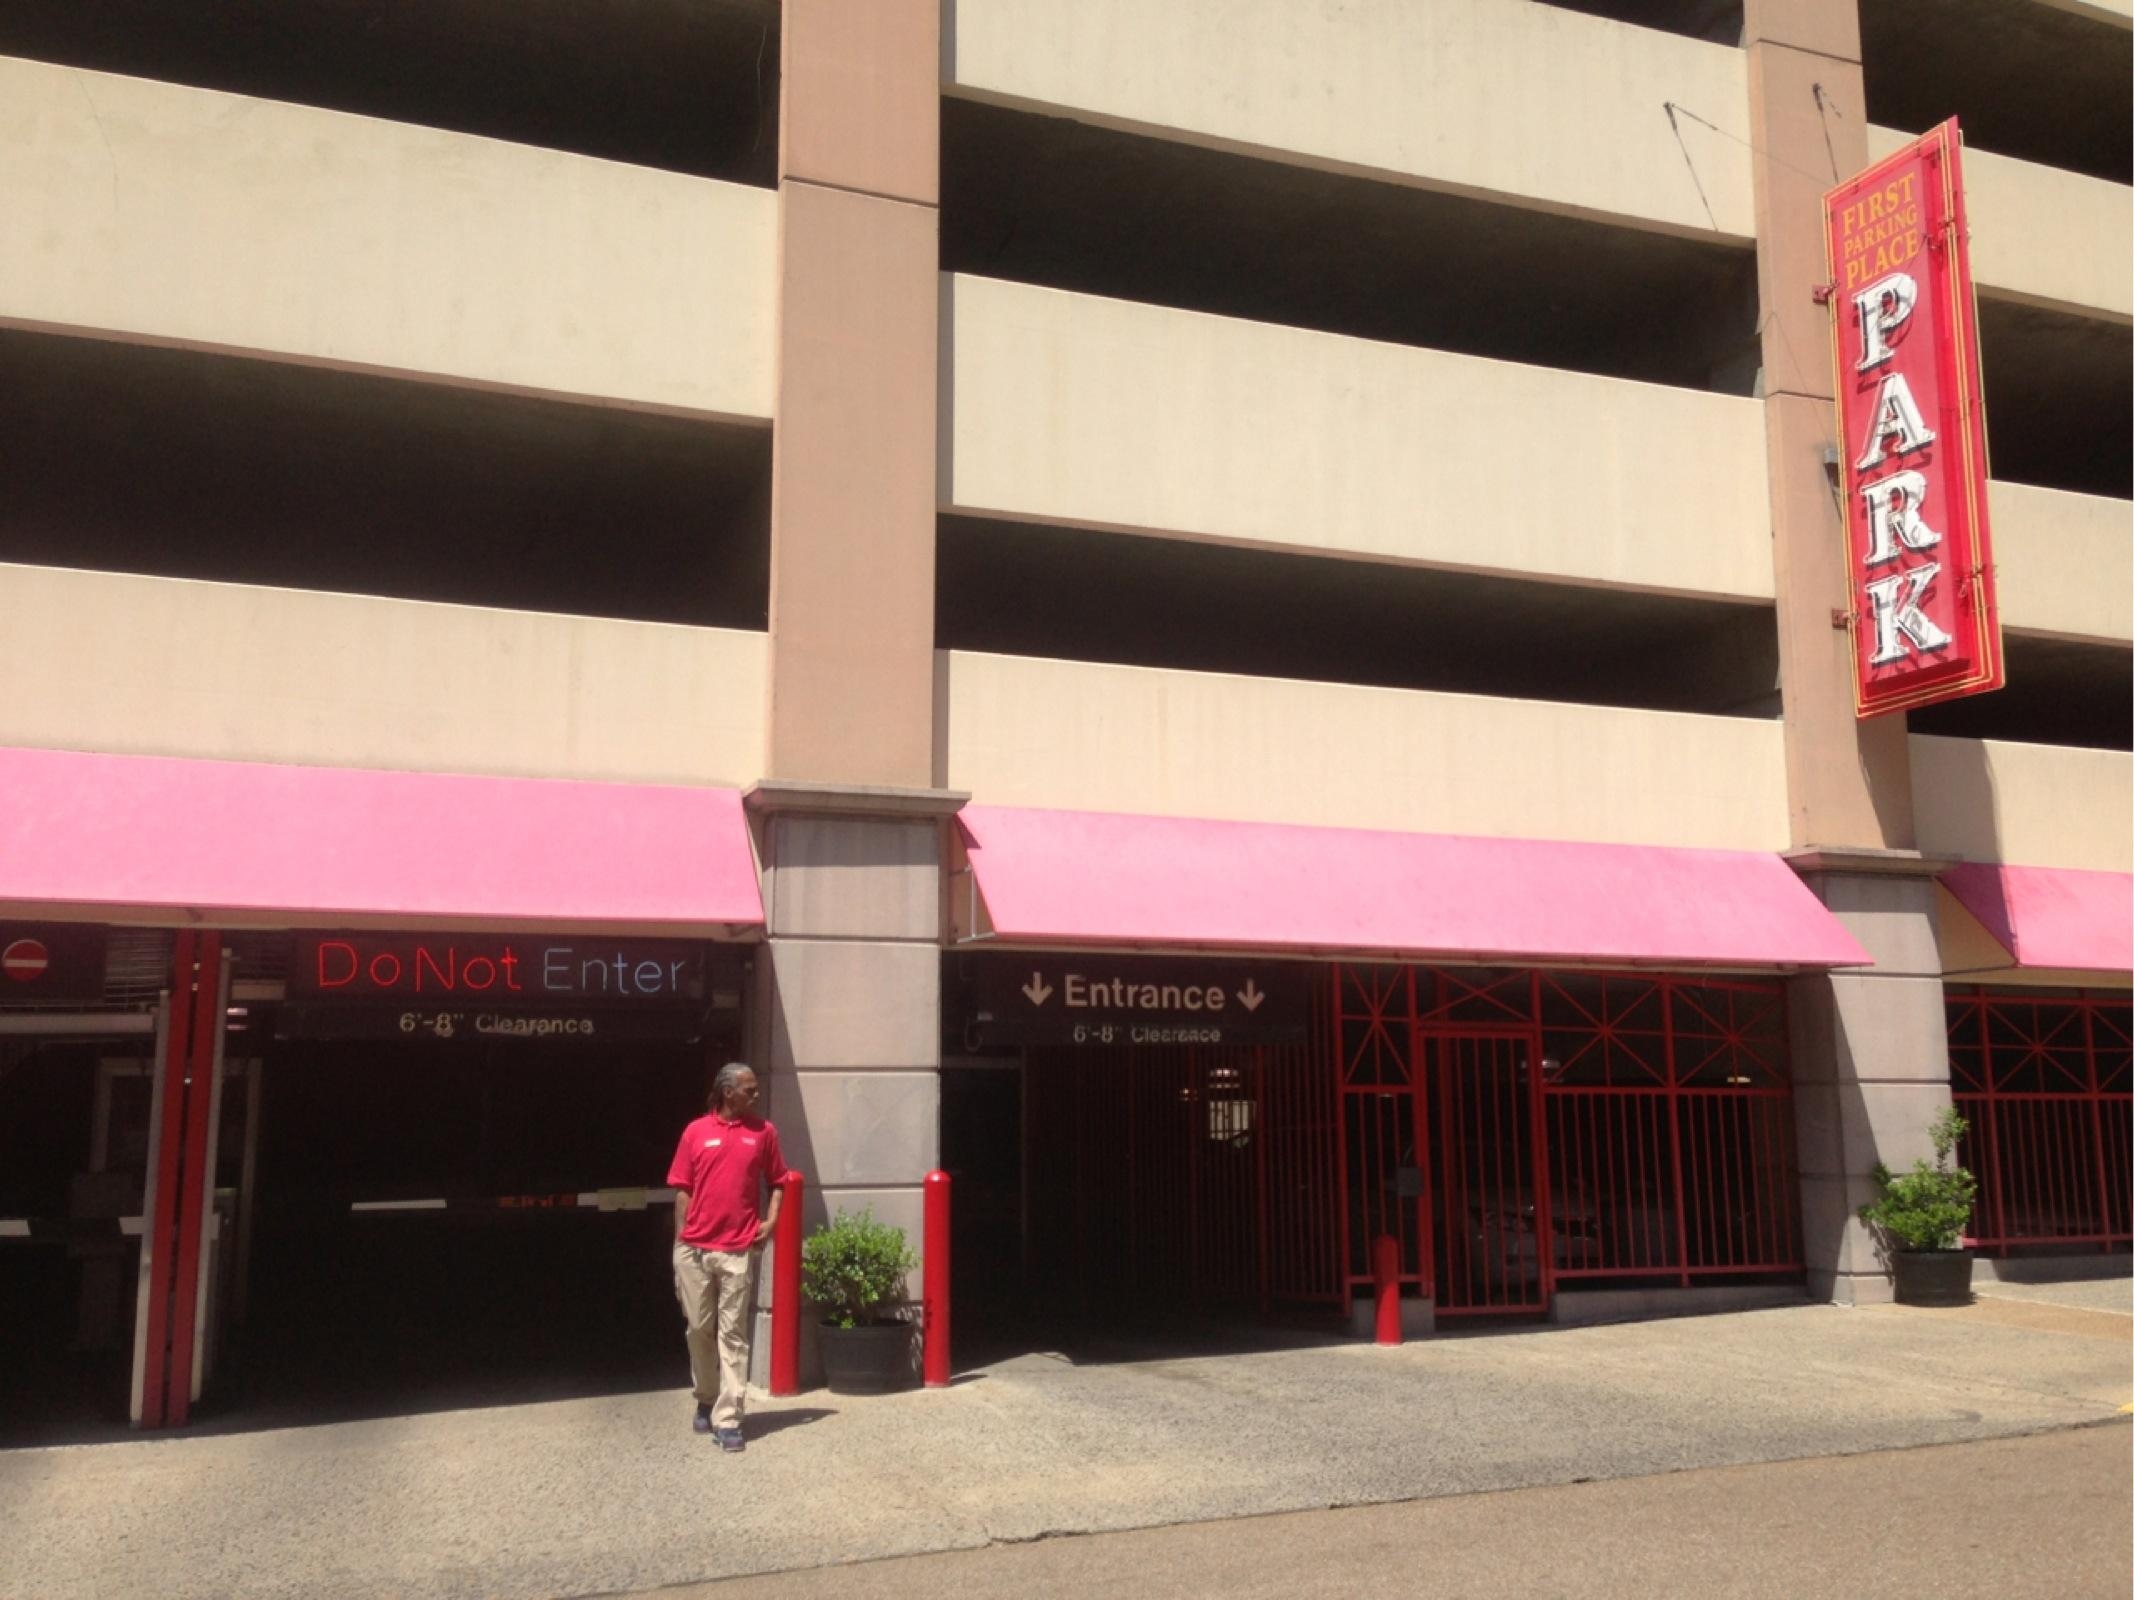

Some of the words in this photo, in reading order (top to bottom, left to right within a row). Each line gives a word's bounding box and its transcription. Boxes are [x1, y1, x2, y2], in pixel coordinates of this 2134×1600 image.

[1842, 171, 1917, 236] FIRST
[1843, 204, 1919, 262] PARKING
[1845, 228, 1920, 290] PLACE
[1851, 272, 1953, 667] PARK
[317, 940, 401, 988] Do
[415, 945, 521, 992] Not
[543, 947, 686, 994] Enter
[1064, 974, 1226, 1010] Entrance
[475, 1014, 596, 1036] Clearance
[1131, 1024, 1222, 1043] Clearance
